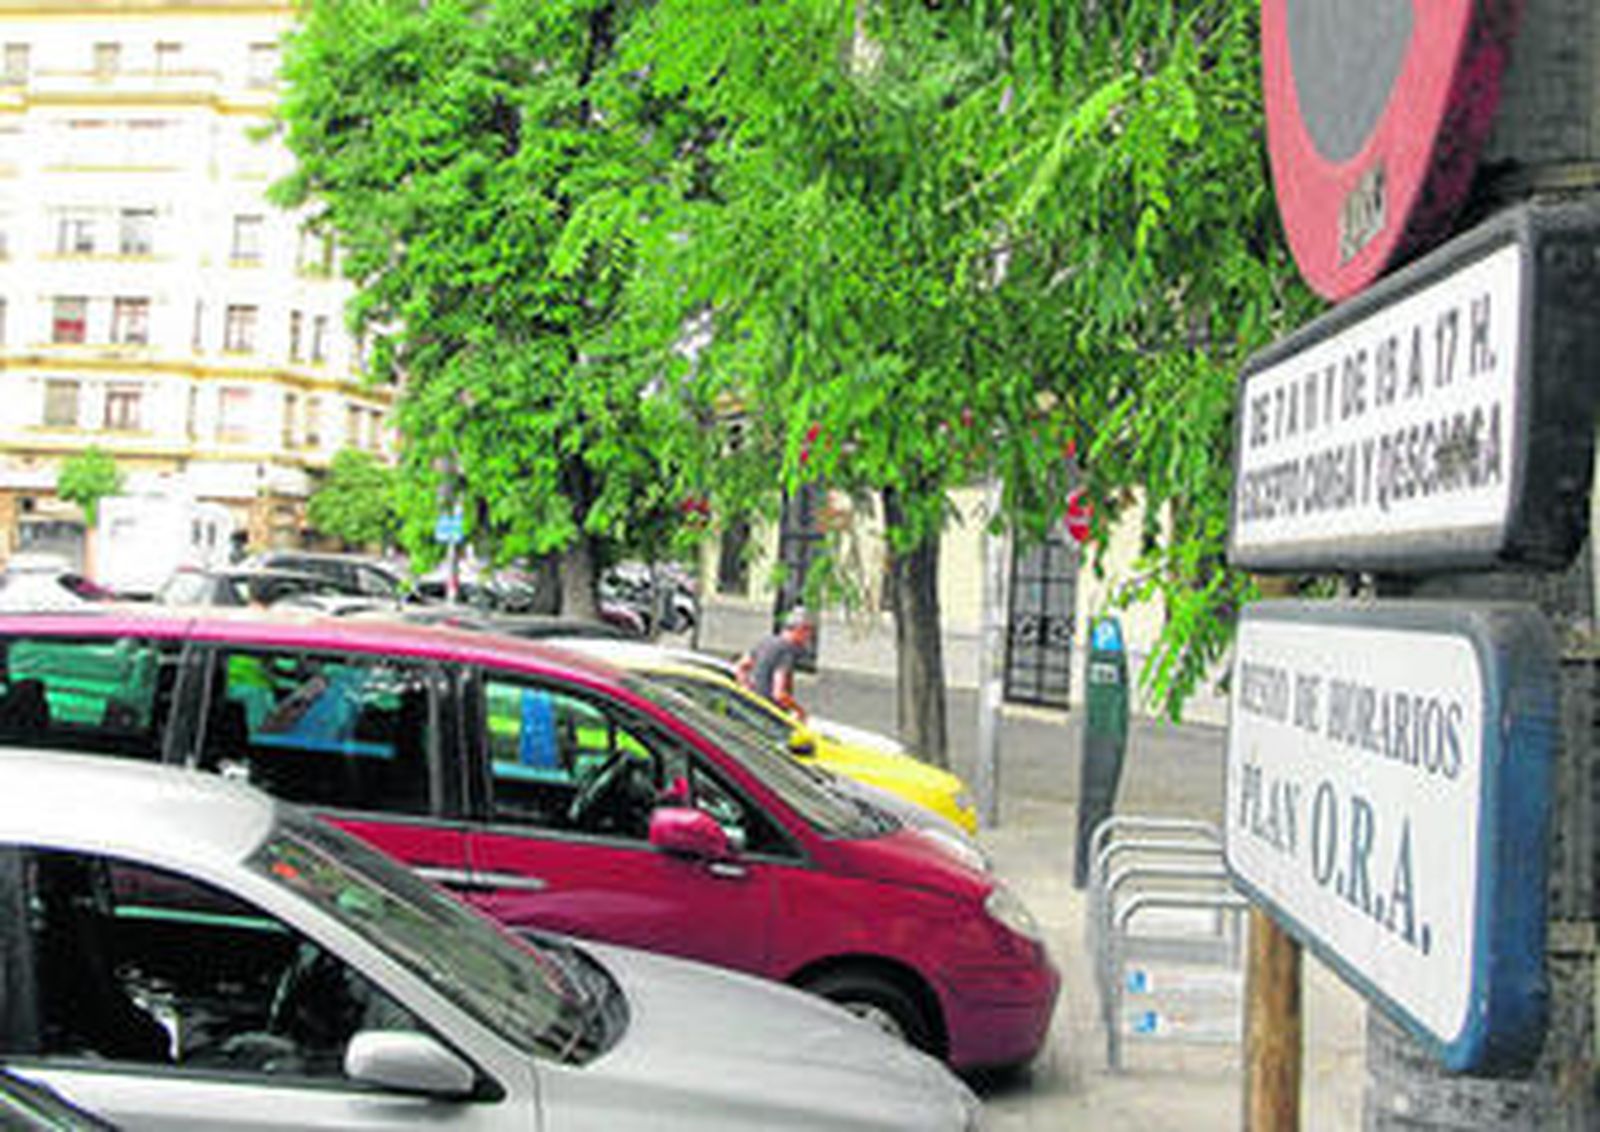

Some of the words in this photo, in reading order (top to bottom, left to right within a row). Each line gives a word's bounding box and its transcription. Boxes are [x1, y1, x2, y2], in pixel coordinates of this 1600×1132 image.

[1341, 348, 1367, 422] DE
[1407, 325, 1425, 400] A
[1436, 308, 1459, 389] 17
[1470, 292, 1496, 379] H.
[1360, 437, 1375, 505] Y
[1294, 673, 1321, 732] DE
[1326, 678, 1463, 779] HORARIOS
[1239, 762, 1302, 856] PLAN
[1312, 780, 1432, 956] O.R.A.
